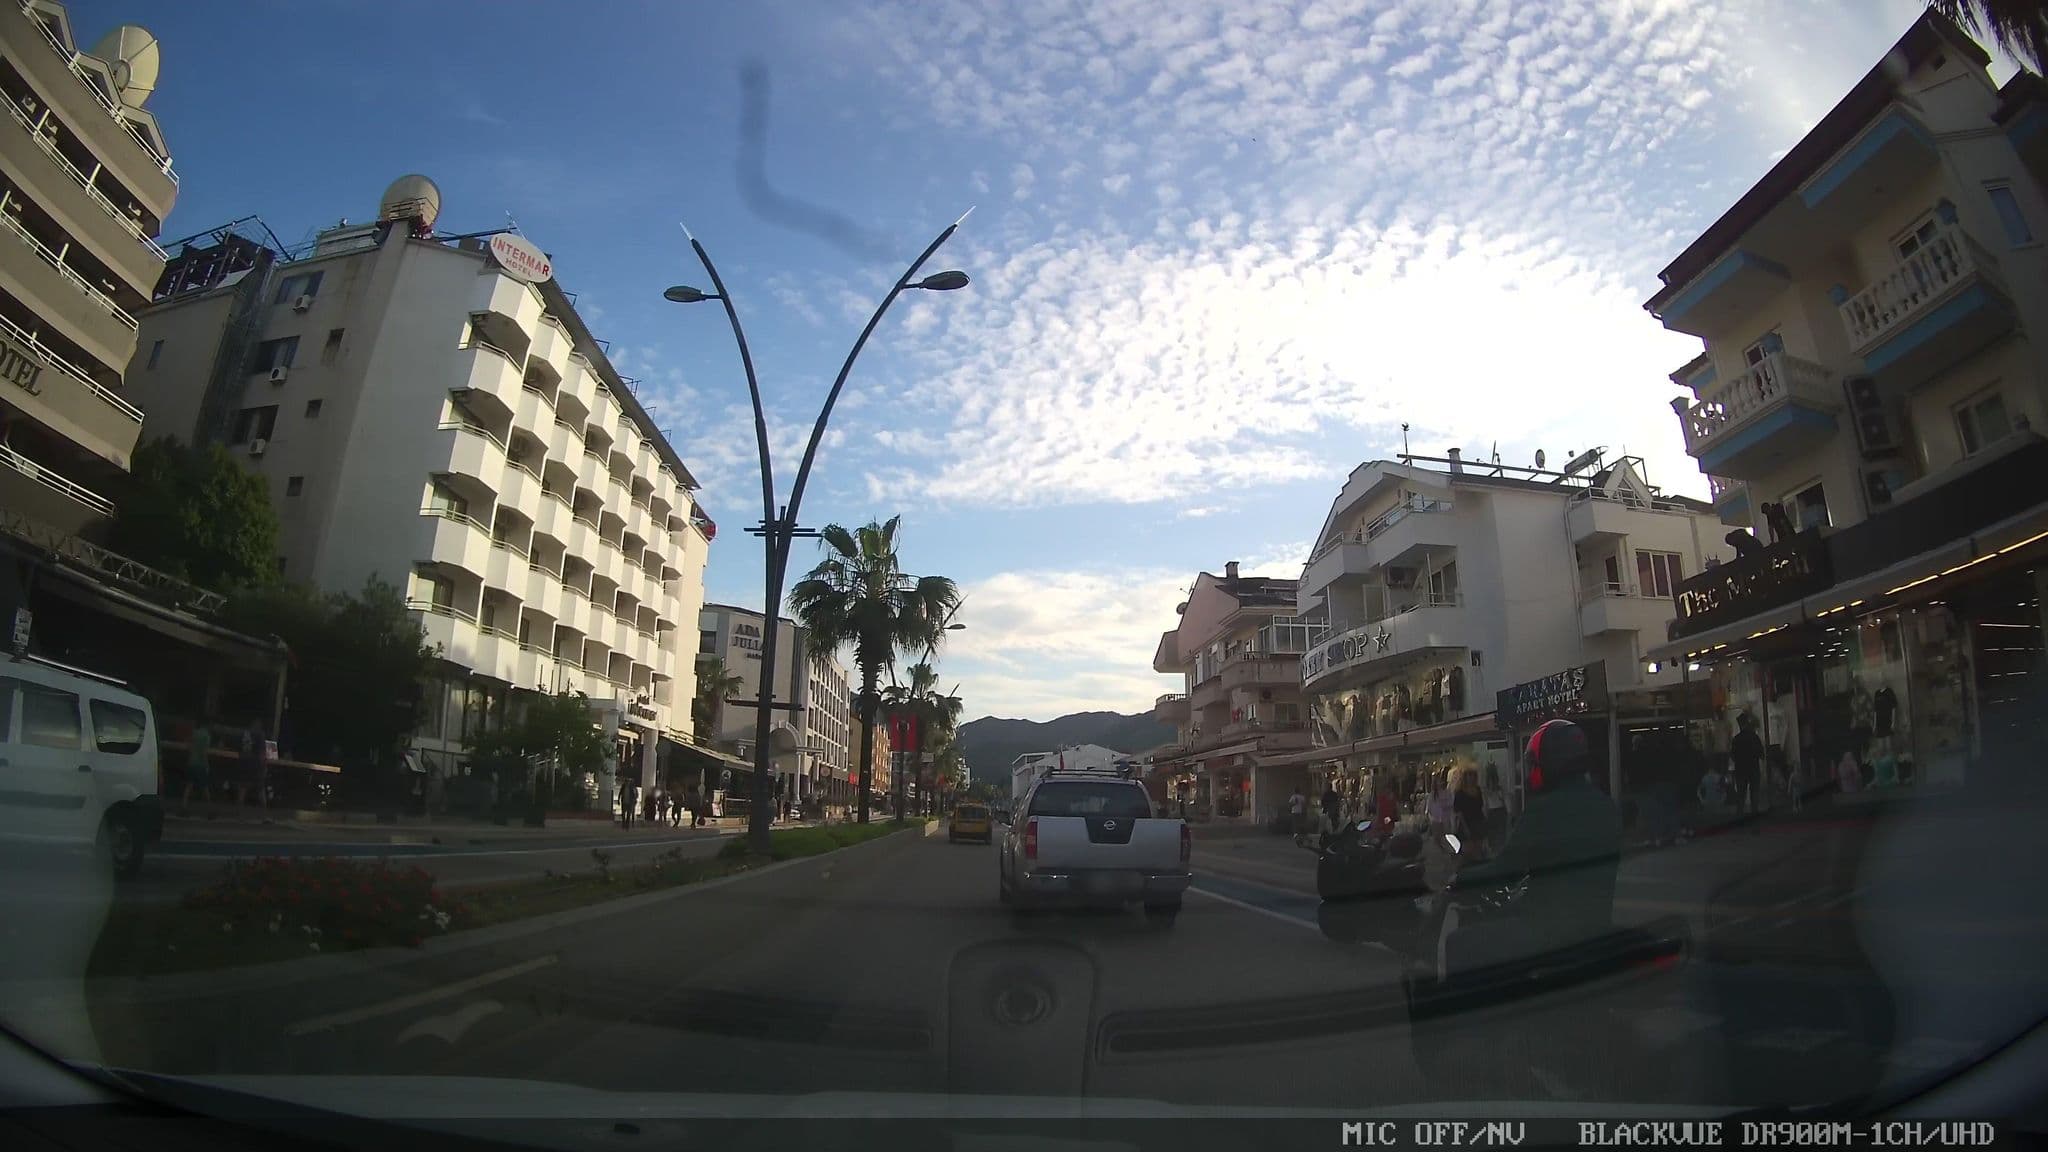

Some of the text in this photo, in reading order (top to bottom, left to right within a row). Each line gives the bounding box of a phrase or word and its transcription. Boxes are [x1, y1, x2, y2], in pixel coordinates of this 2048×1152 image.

[493, 236, 550, 276] INTERMAR
[505, 257, 533, 278] HOTEL
[735, 623, 761, 638] ADA
[1516, 699, 1546, 714] APART
